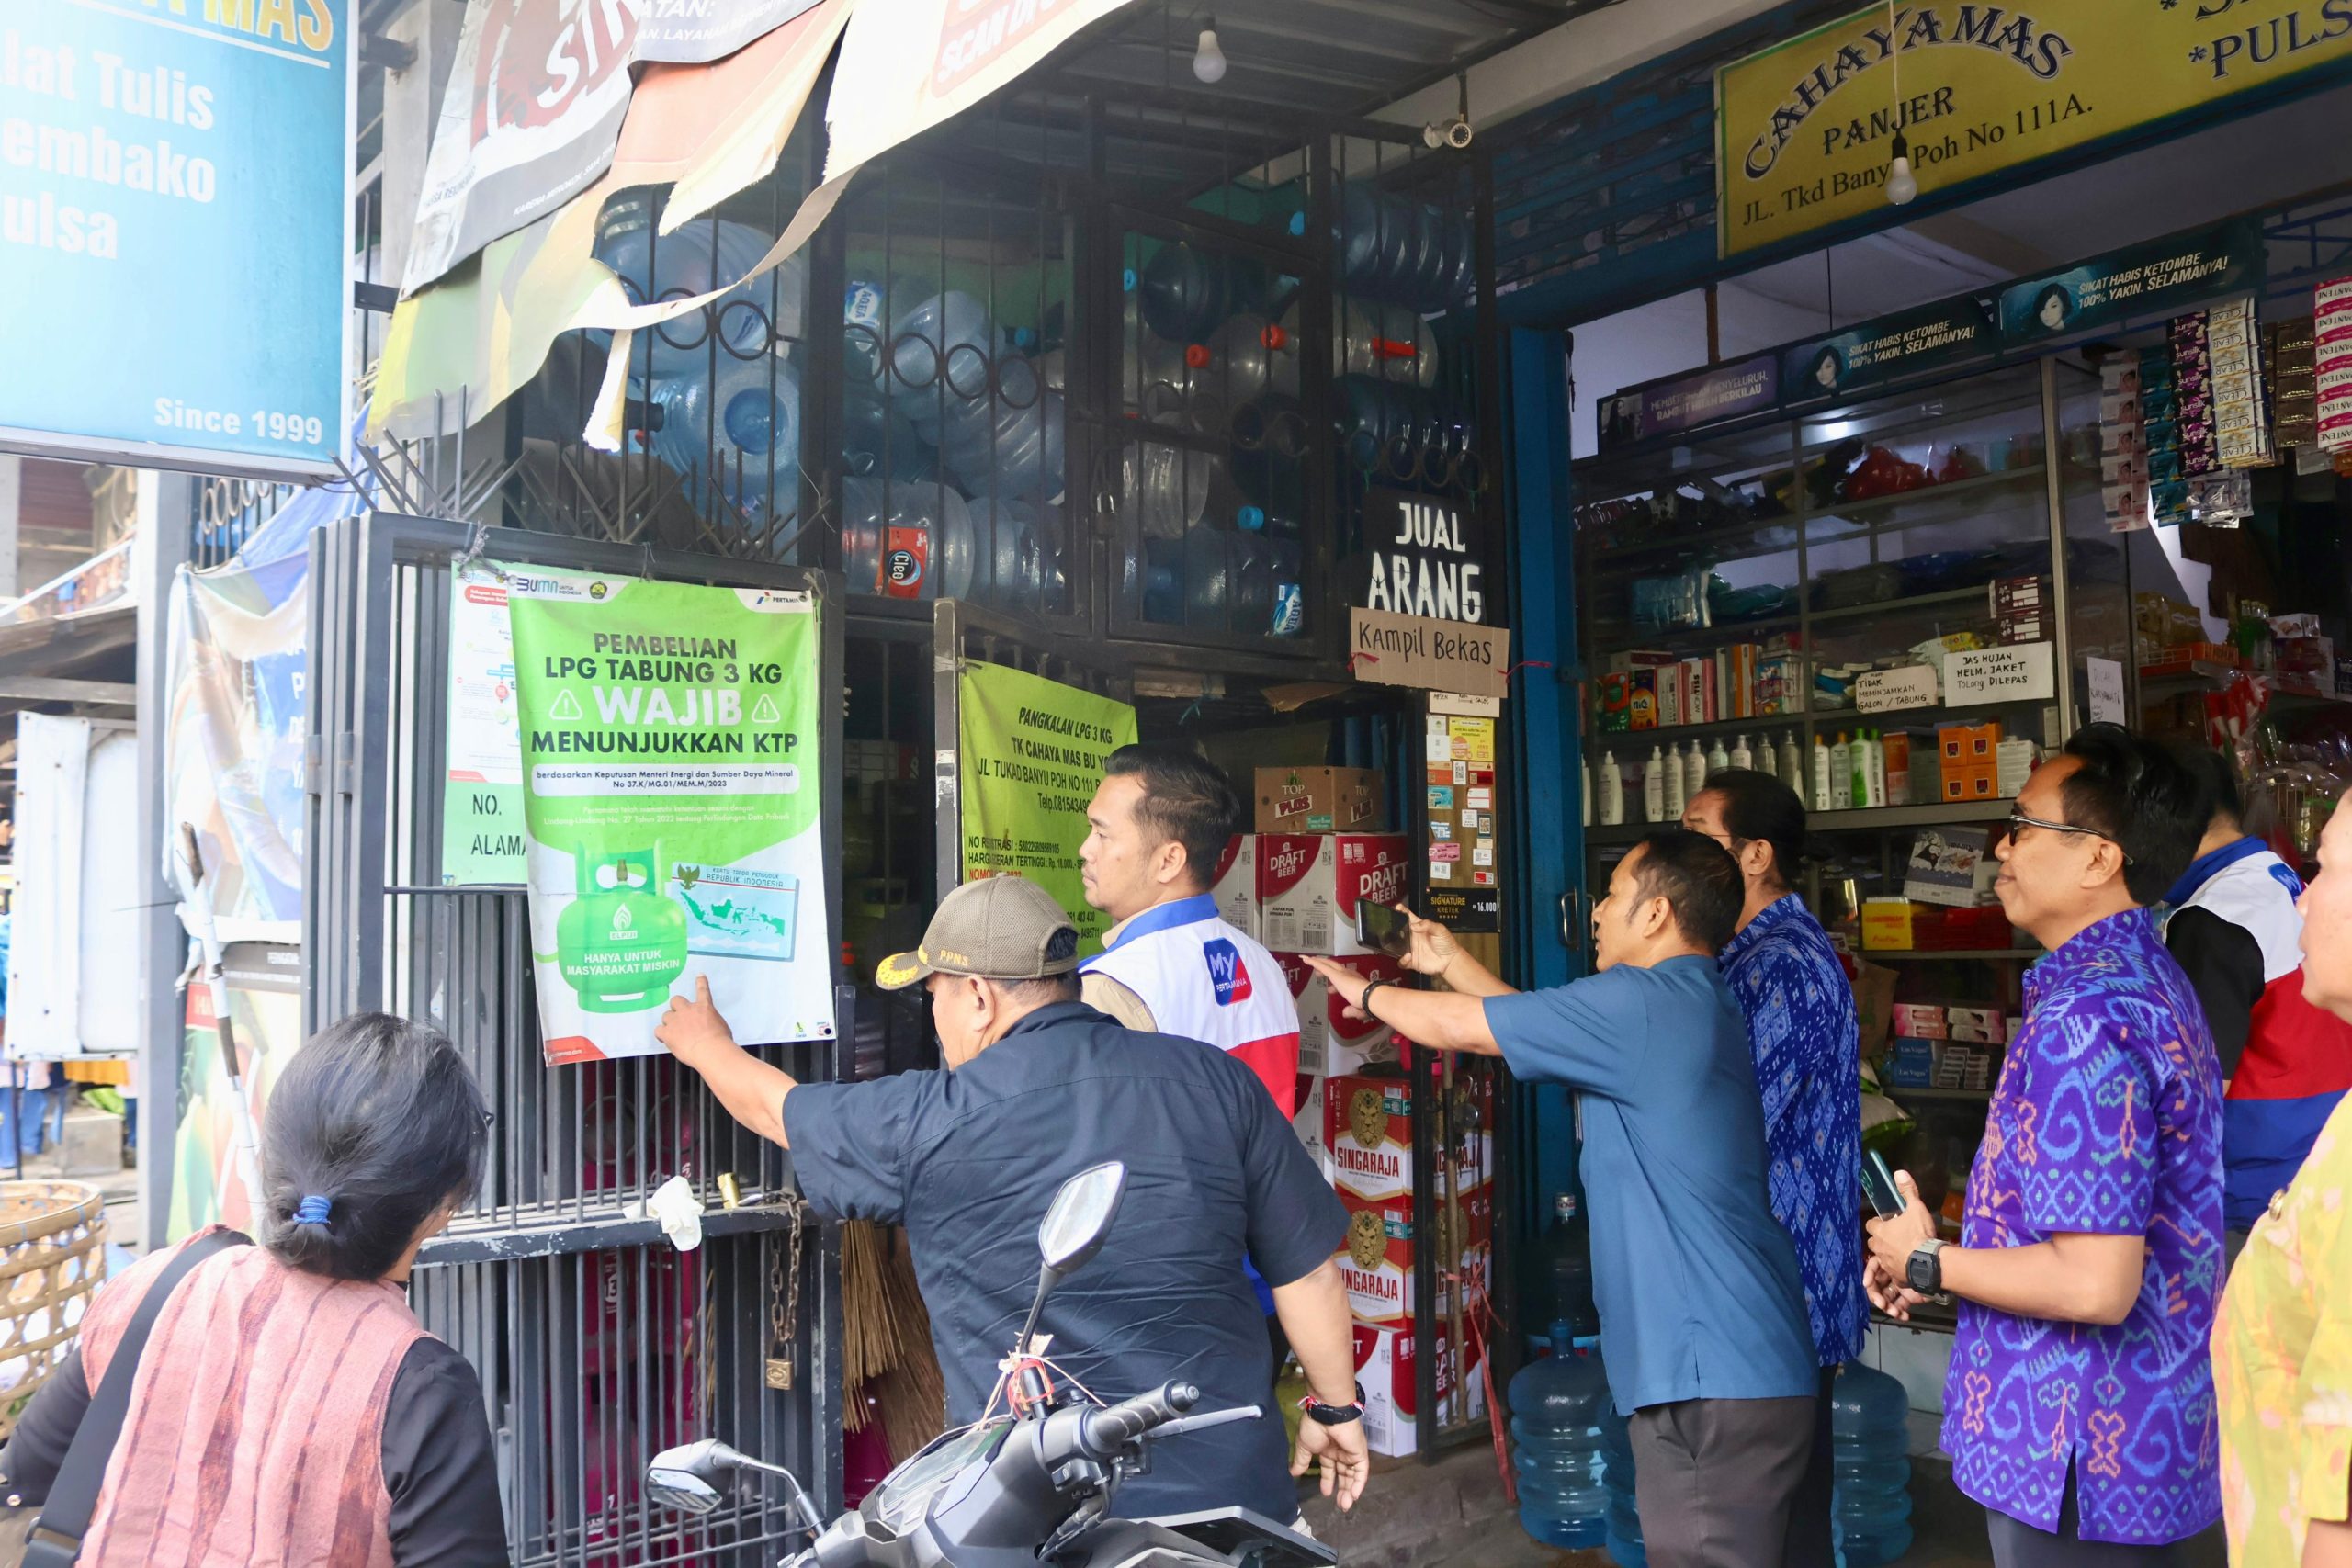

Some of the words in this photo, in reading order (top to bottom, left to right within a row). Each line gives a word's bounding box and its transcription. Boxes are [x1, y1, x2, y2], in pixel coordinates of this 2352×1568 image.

[1, 28, 77, 101] lat
[93, 51, 214, 130] Tulis
[1824, 86, 1955, 154] PANJER
[1, 117, 216, 203] embako
[1744, 201, 1774, 226] JL.
[1782, 180, 1826, 212] Tkd
[1833, 162, 1891, 197] Bany
[1913, 137, 1959, 169] Poh
[1966, 122, 2005, 147] No
[2016, 94, 2093, 137] 111A.
[1, 191, 118, 260] ulsa
[2078, 276, 2109, 296] SIKAT
[2110, 268, 2142, 288] HABIS
[2143, 253, 2201, 277] KETOMBE
[2078, 292, 2108, 310] 100%
[2109, 282, 2143, 301] YAKIN.
[2147, 256, 2229, 290] SELAMANYA!
[854, 289, 873, 320] AQUA
[2212, 309, 2242, 322] CLEAR
[1849, 341, 1874, 356] SIKAT
[1874, 333, 1902, 350] HABIS
[1903, 320, 1951, 342] KETOMBE
[1849, 355, 1872, 369] 100%
[1874, 345, 1903, 363] YAKIN.
[1905, 325, 1975, 355] SELAMANYA!
[2213, 334, 2243, 348] CLEAR
[2215, 362, 2245, 375] CLEAR
[1719, 383, 1762, 405] BERKILAU
[2218, 389, 2248, 402] CLEAR
[154, 397, 241, 434] Since
[250, 410, 322, 445] 1999
[2220, 417, 2250, 430] CLEAR
[2222, 445, 2252, 458] CLEAR
[1396, 502, 1465, 553] JUAL
[892, 555, 909, 580] Cleo
[1368, 551, 1481, 623] ARANG
[594, 633, 738, 660] PEMBELIAN
[1434, 632, 1492, 665] Bekas
[545, 656, 597, 680] LPG
[606, 659, 715, 683] TABUNG
[724, 664, 740, 683] 3
[749, 664, 783, 684] KG
[1962, 655, 1978, 666] JAS
[1982, 652, 2012, 664] HUJAN
[1990, 661, 2026, 674] JAKET
[1858, 684, 1916, 699] MEMINJAMKAN
[1989, 675, 2028, 687] DILEPAS
[592, 685, 742, 726] WAJIB
[1857, 698, 1883, 711] GALON
[1895, 693, 1928, 705] TABUNG
[1018, 707, 1074, 737] PANGKALAN
[1075, 722, 1091, 739] LPG
[1092, 726, 1099, 742] 3
[1100, 727, 1113, 744] KG
[531, 732, 743, 753] MENUNJUKKAN
[754, 733, 798, 753] KTP
[1012, 737, 1024, 754] TK
[1025, 741, 1061, 763] CAHAYA
[1063, 749, 1082, 767] MAS
[1083, 750, 1096, 770] BU
[537, 771, 593, 780] berdasarkan
[594, 771, 637, 781] Keputusan
[639, 770, 669, 779] Menteri
[671, 770, 695, 780] Energi
[695, 770, 710, 779] dan
[712, 770, 741, 779] Sumber
[743, 770, 763, 780] Daya
[765, 769, 794, 778] Mineral
[613, 780, 625, 788] No
[978, 758, 990, 777] JL
[994, 759, 1023, 782] TUKAD
[1023, 765, 1049, 787] BANYU
[1051, 772, 1067, 789] POH
[1069, 774, 1080, 791] NO
[1282, 784, 1306, 795] TOP
[1355, 785, 1369, 796] TOP
[471, 794, 503, 816] NO.
[969, 836, 980, 848] NO
[1270, 849, 1306, 871] DRAFT
[707, 873, 741, 885] REPUBLIK
[743, 877, 785, 887] INDONESIA
[1277, 865, 1297, 878] BEER
[1359, 861, 1408, 896] DRAFT
[1372, 886, 1397, 905] BEER
[1430, 897, 1465, 906] SIGNATURE
[1477, 902, 1497, 912] 16.000
[566, 962, 641, 976] MASYARAKAT
[643, 959, 680, 974] MISKIN
[583, 952, 621, 964] HANYA
[623, 950, 662, 962] UNTUK
[940, 950, 969, 966] PPNS
[1337, 1146, 1399, 1178] SINGARAJA
[1339, 1269, 1398, 1301] INGARAJA
